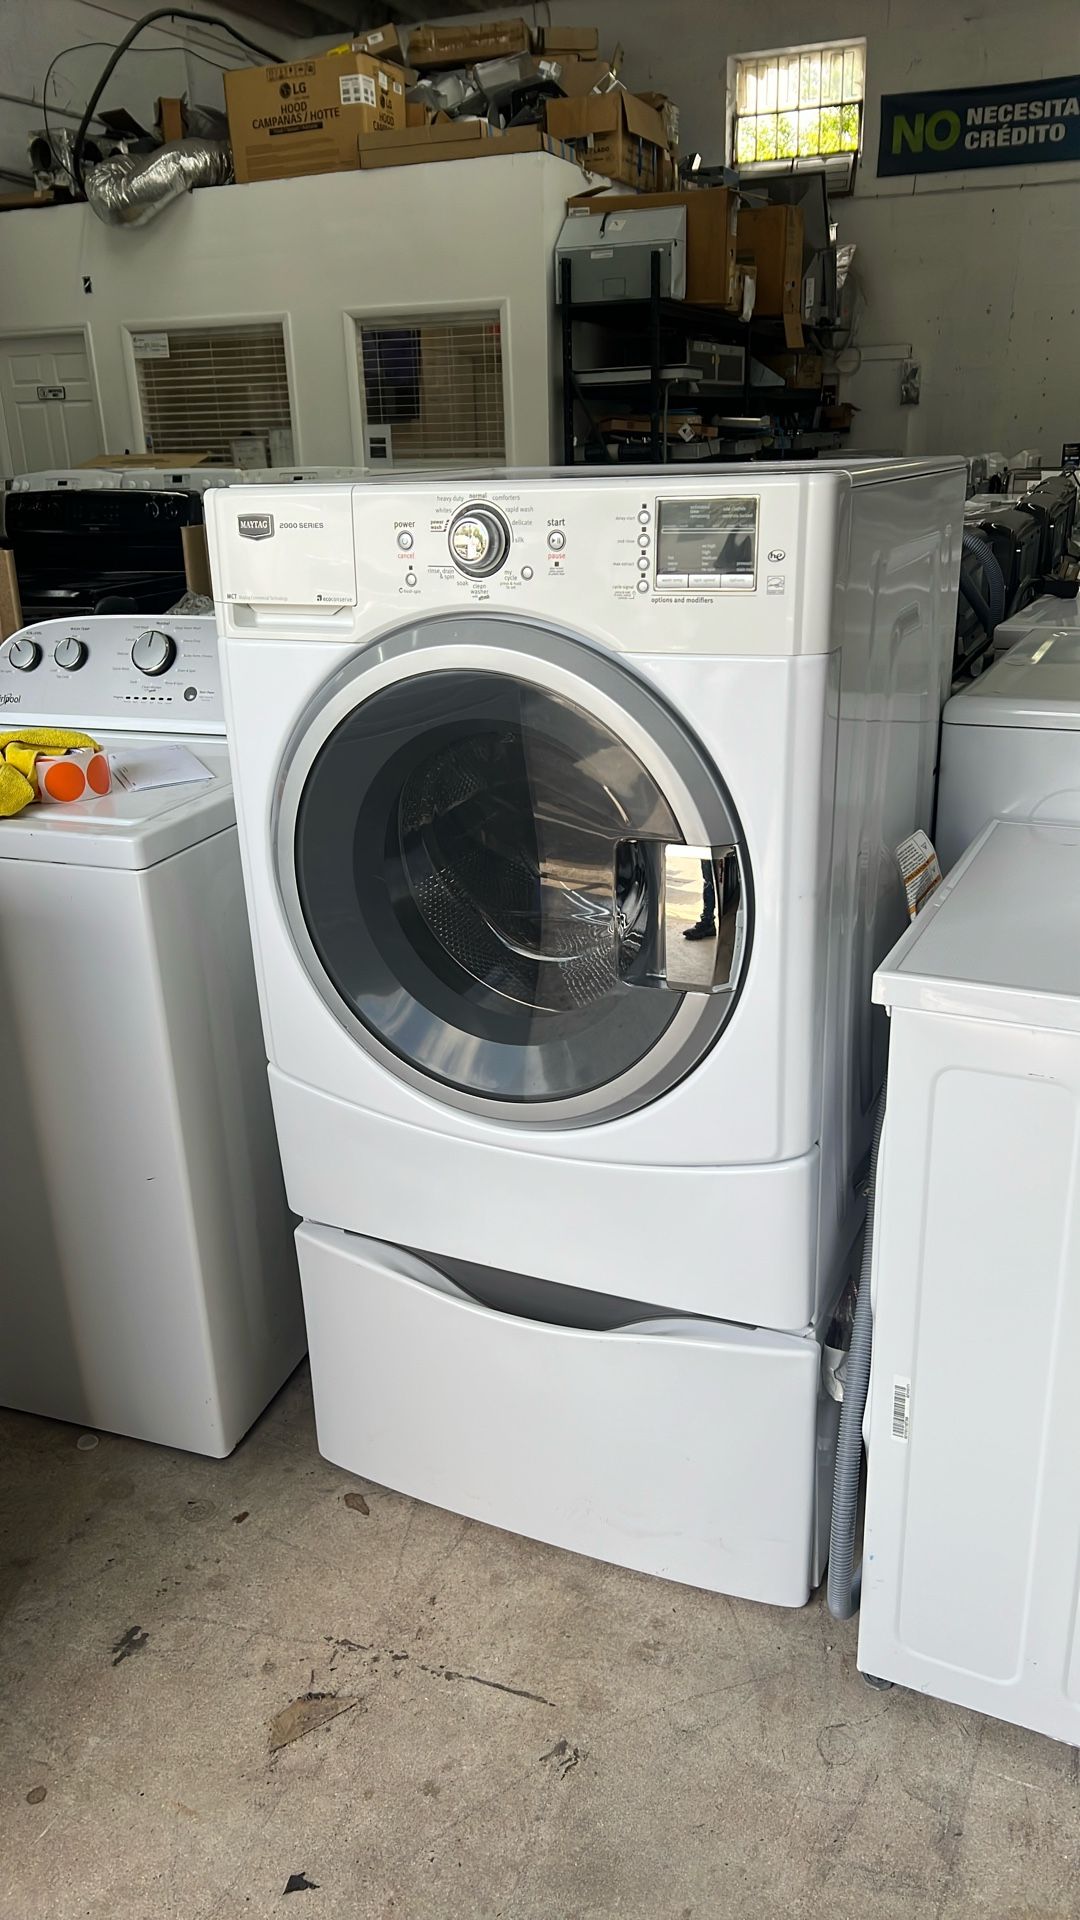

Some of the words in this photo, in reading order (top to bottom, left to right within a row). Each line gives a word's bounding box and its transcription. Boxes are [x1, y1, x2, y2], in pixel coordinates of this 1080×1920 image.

[292, 82, 306, 95] LG
[280, 101, 307, 114] HOOD
[252, 113, 302, 129] CAMPANAS
[310, 107, 340, 121] HOTTE
[891, 109, 961, 154] NO
[966, 97, 1080, 126] NECESITA
[964, 122, 1066, 150] CRÉDITO
[240, 520, 268, 529] MAYTAG
[394, 520, 415, 529] power
[547, 518, 566, 527] start
